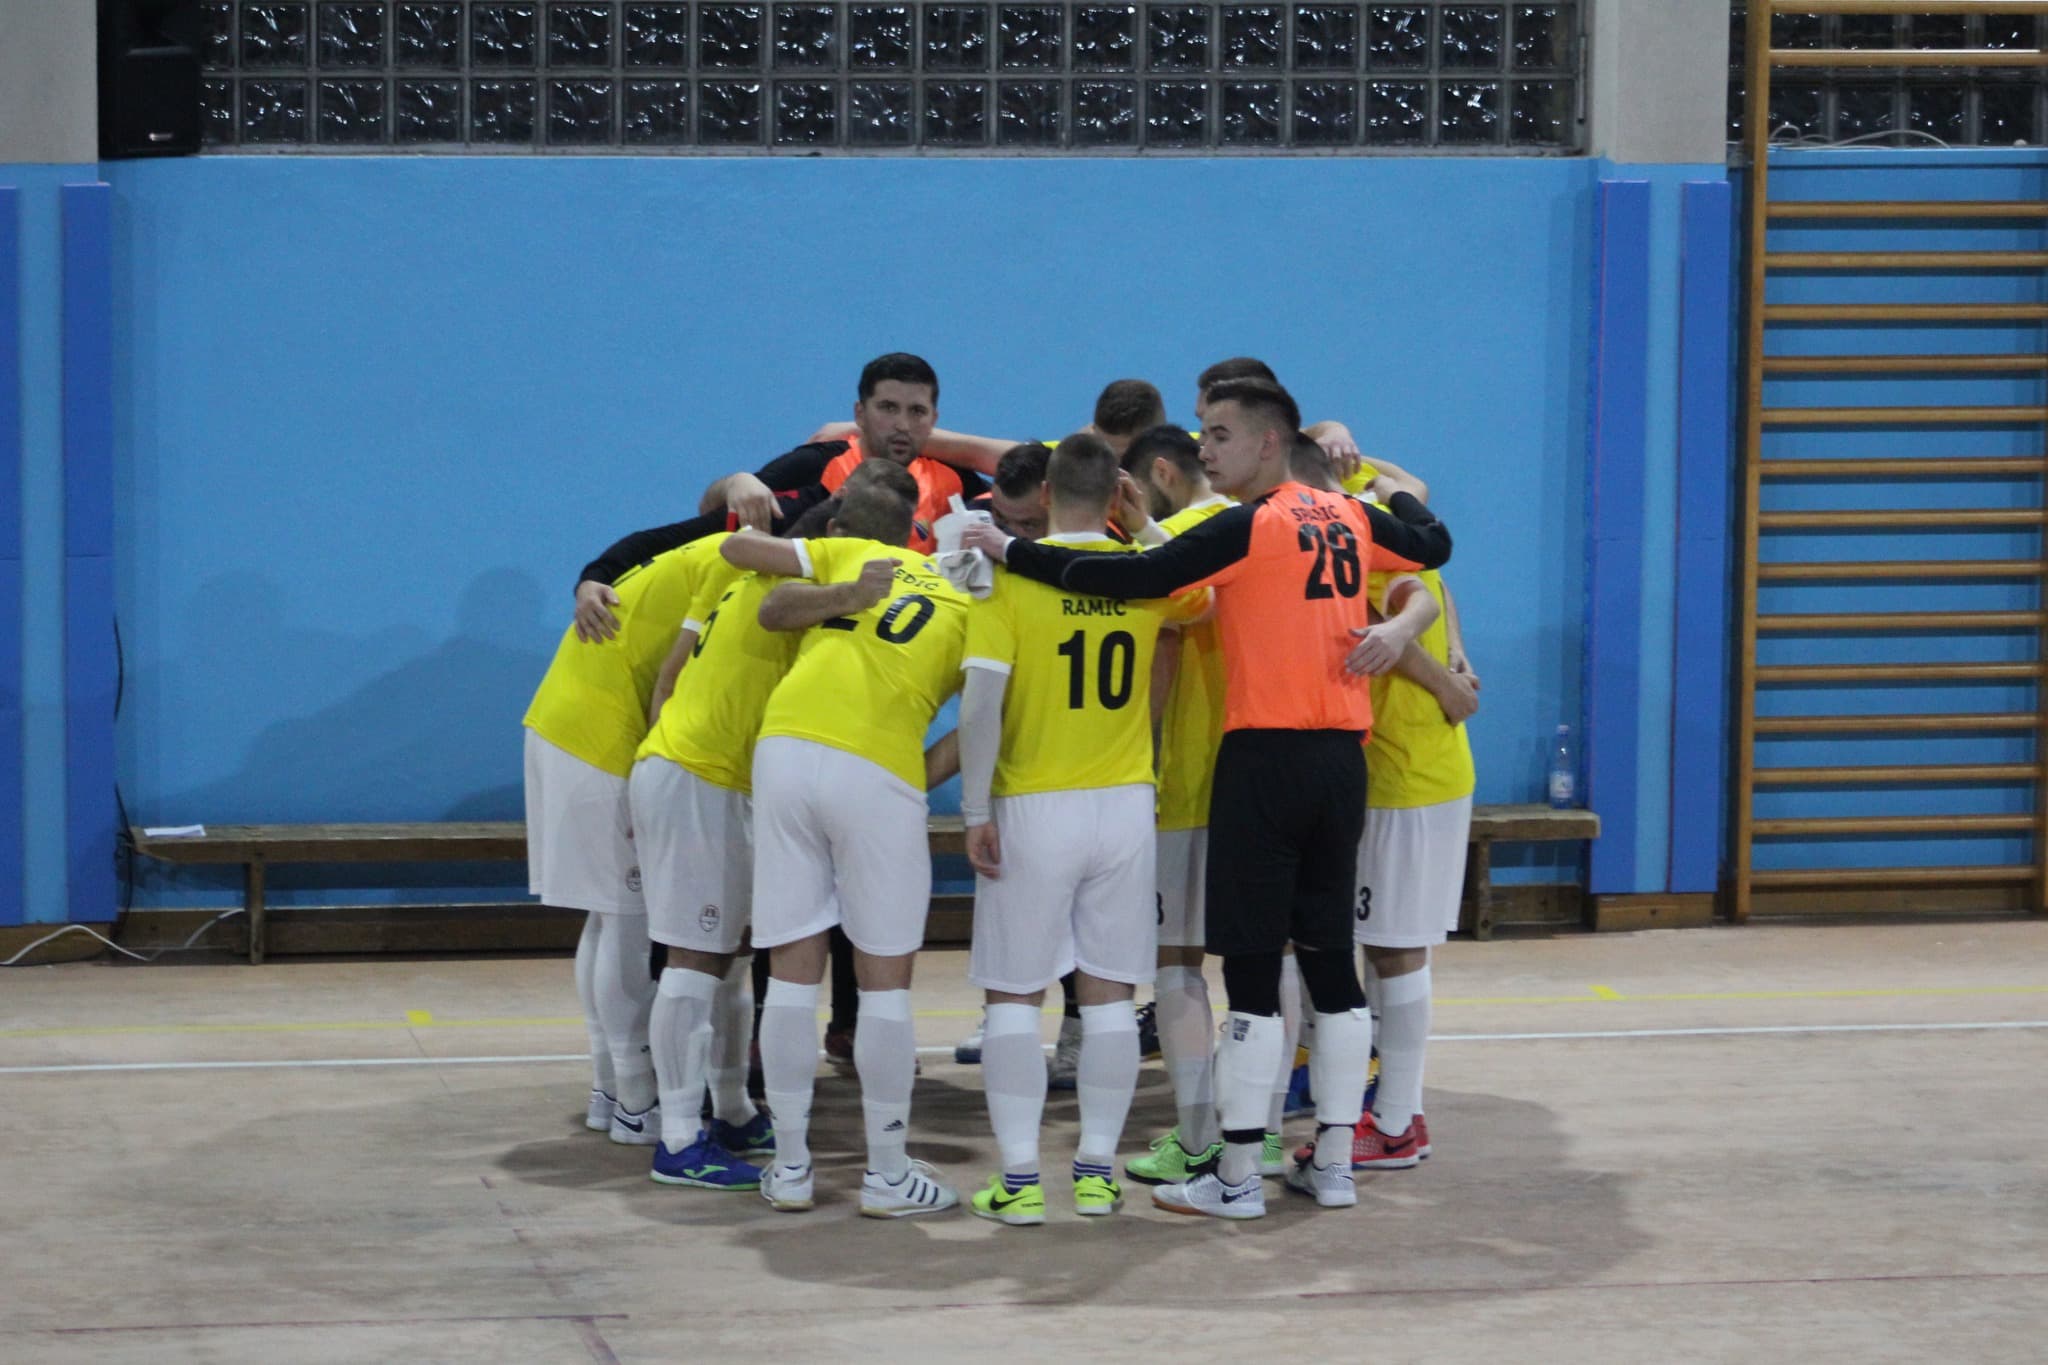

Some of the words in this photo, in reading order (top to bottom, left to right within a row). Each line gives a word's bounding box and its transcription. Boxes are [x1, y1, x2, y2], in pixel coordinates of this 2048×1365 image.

[1298, 521, 1361, 600] 28
[1057, 630, 1136, 710] 10
[1356, 886, 1372, 921] 3
